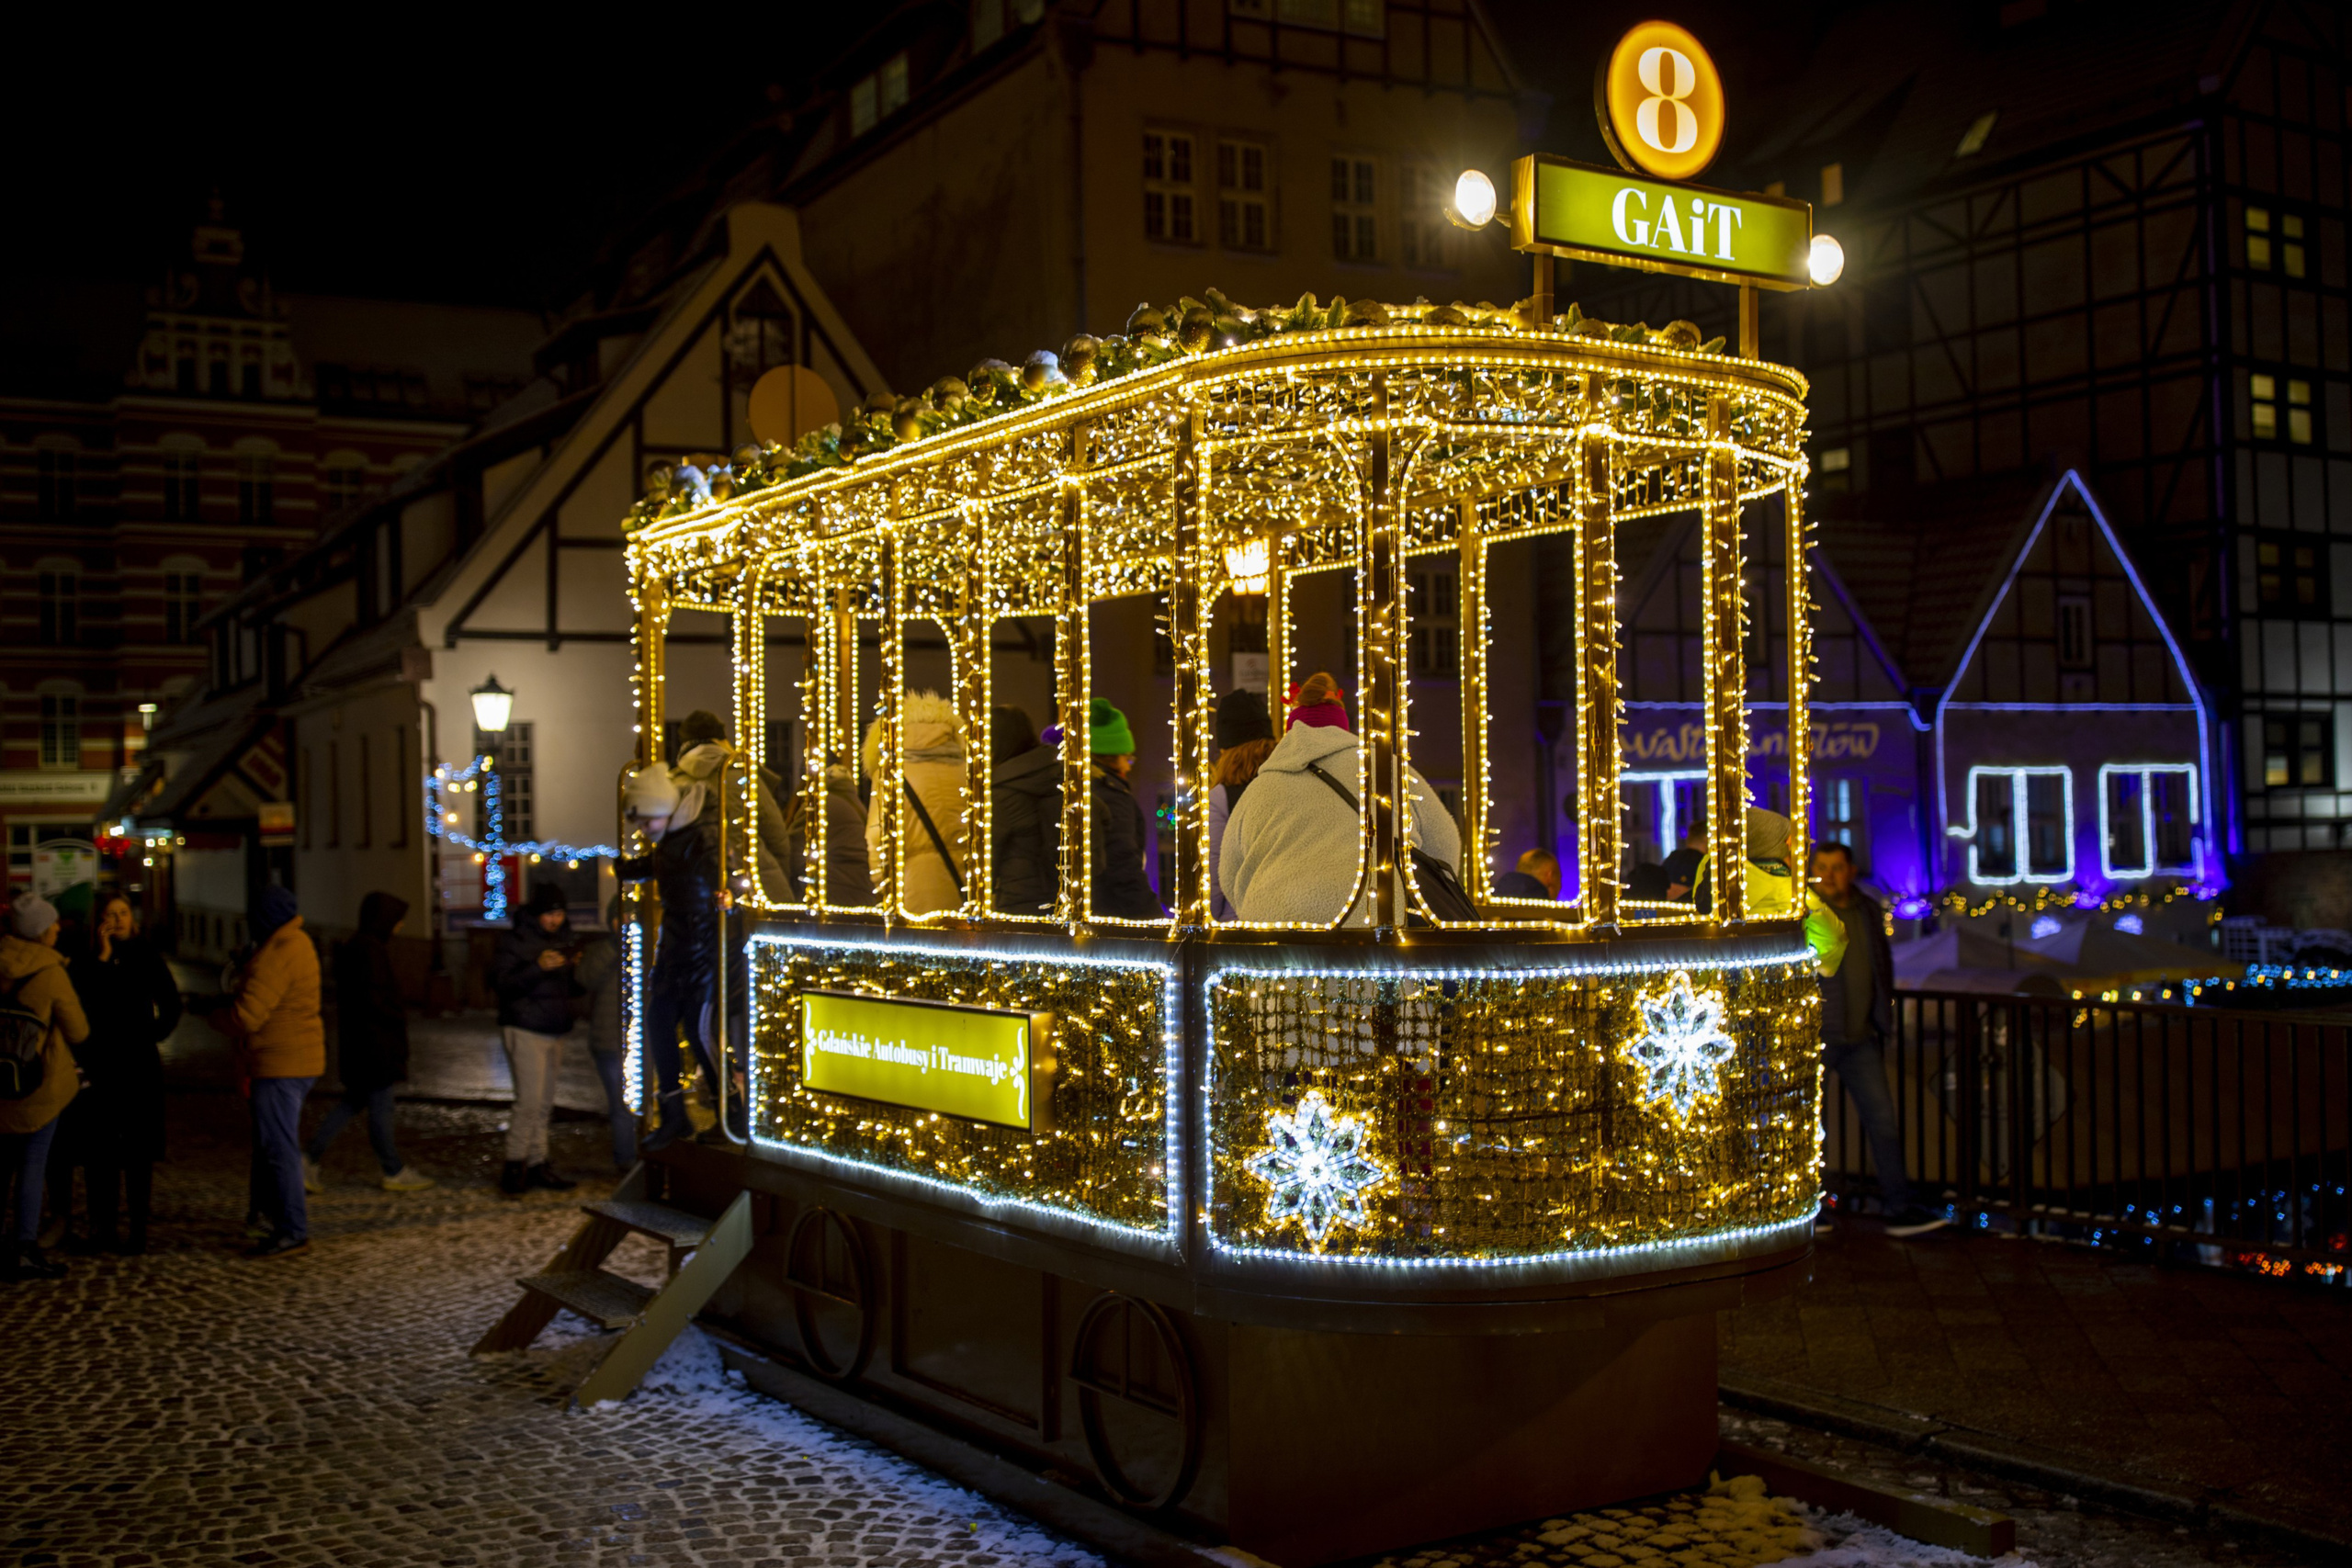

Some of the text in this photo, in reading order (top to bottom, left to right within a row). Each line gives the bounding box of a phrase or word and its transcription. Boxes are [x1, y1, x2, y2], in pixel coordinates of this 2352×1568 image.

[1636, 46, 1698, 153] 8
[1611, 187, 1742, 262] GAiT
[817, 1029, 1008, 1086] Gdańskie Autobusy i Tramwaje
